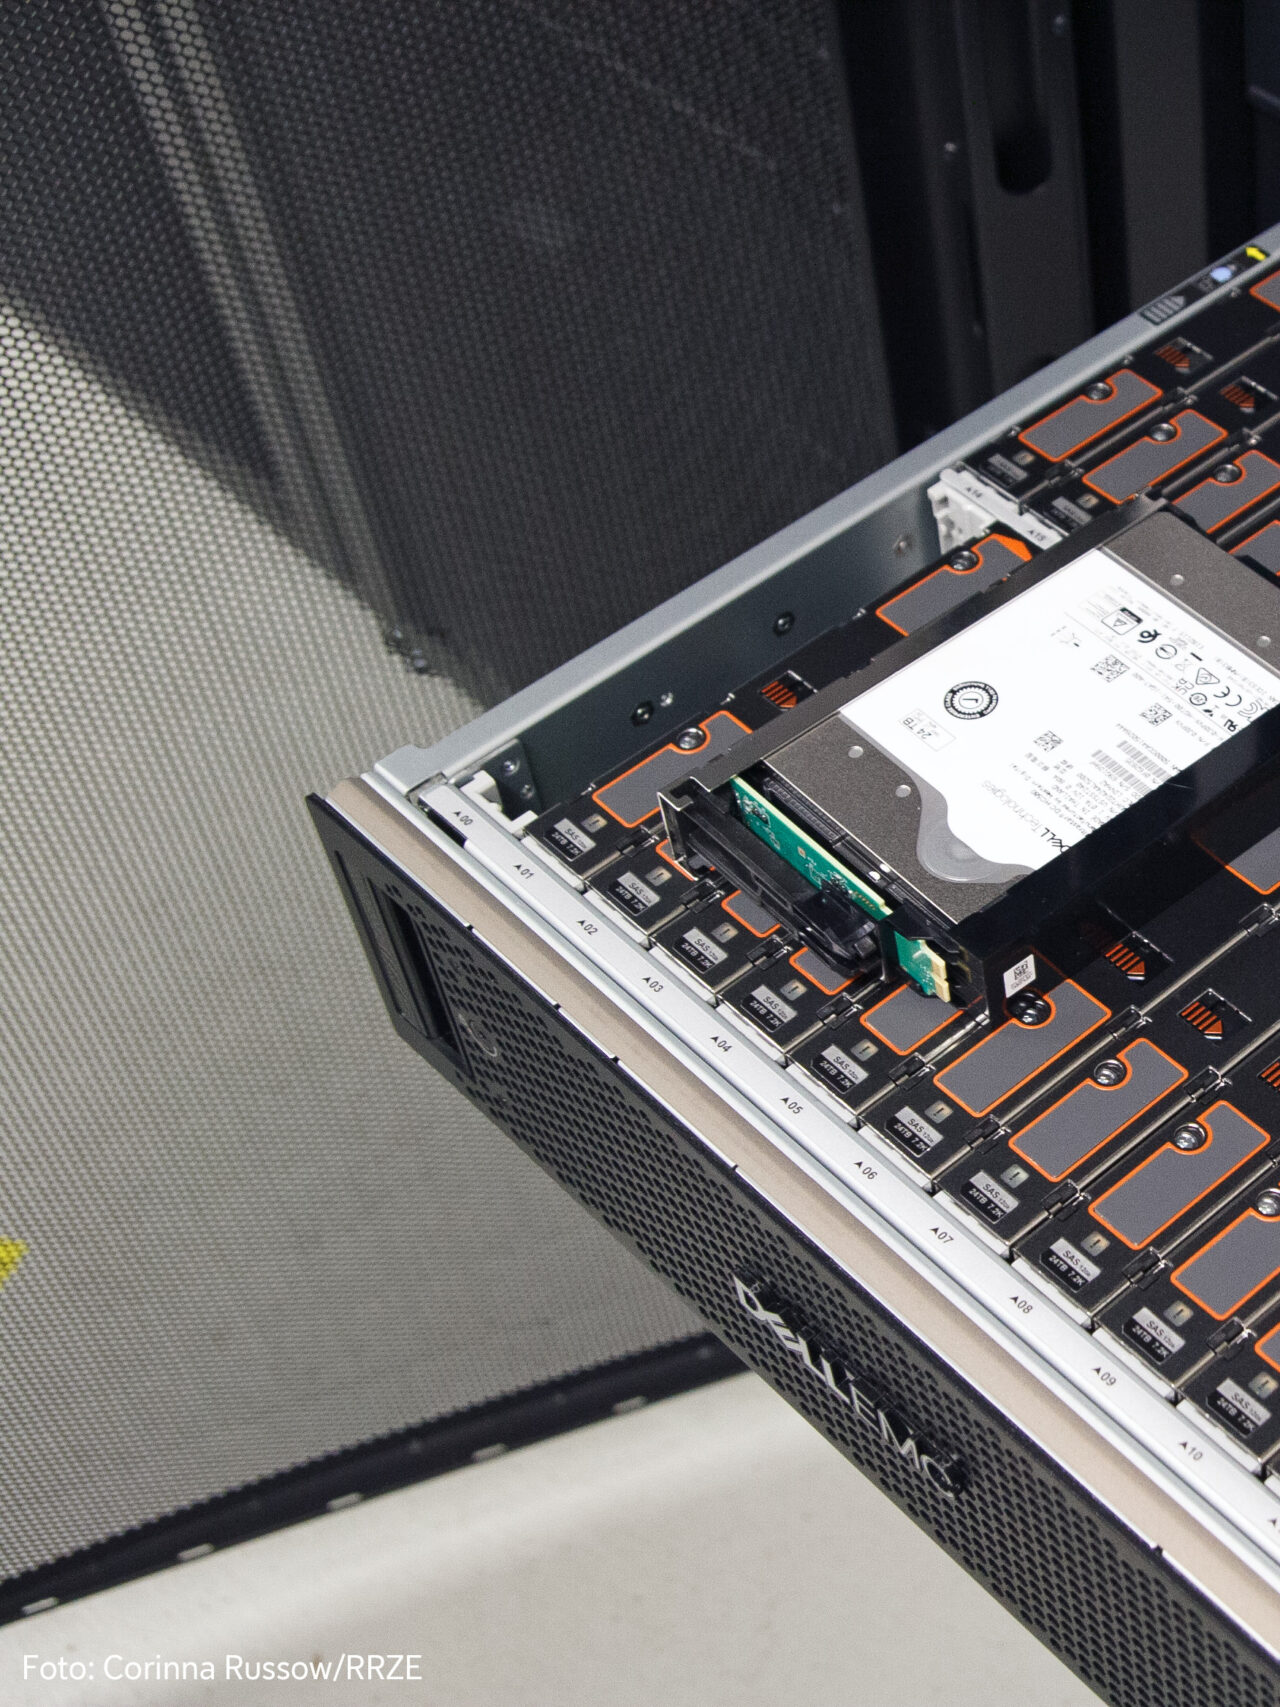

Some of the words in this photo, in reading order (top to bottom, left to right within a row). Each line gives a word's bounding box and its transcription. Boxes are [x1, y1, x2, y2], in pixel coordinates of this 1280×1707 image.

[899, 716, 921, 730] TB
[914, 727, 933, 739] 24
[980, 778, 1047, 832] Technologies
[733, 1277, 850, 1403] DELL
